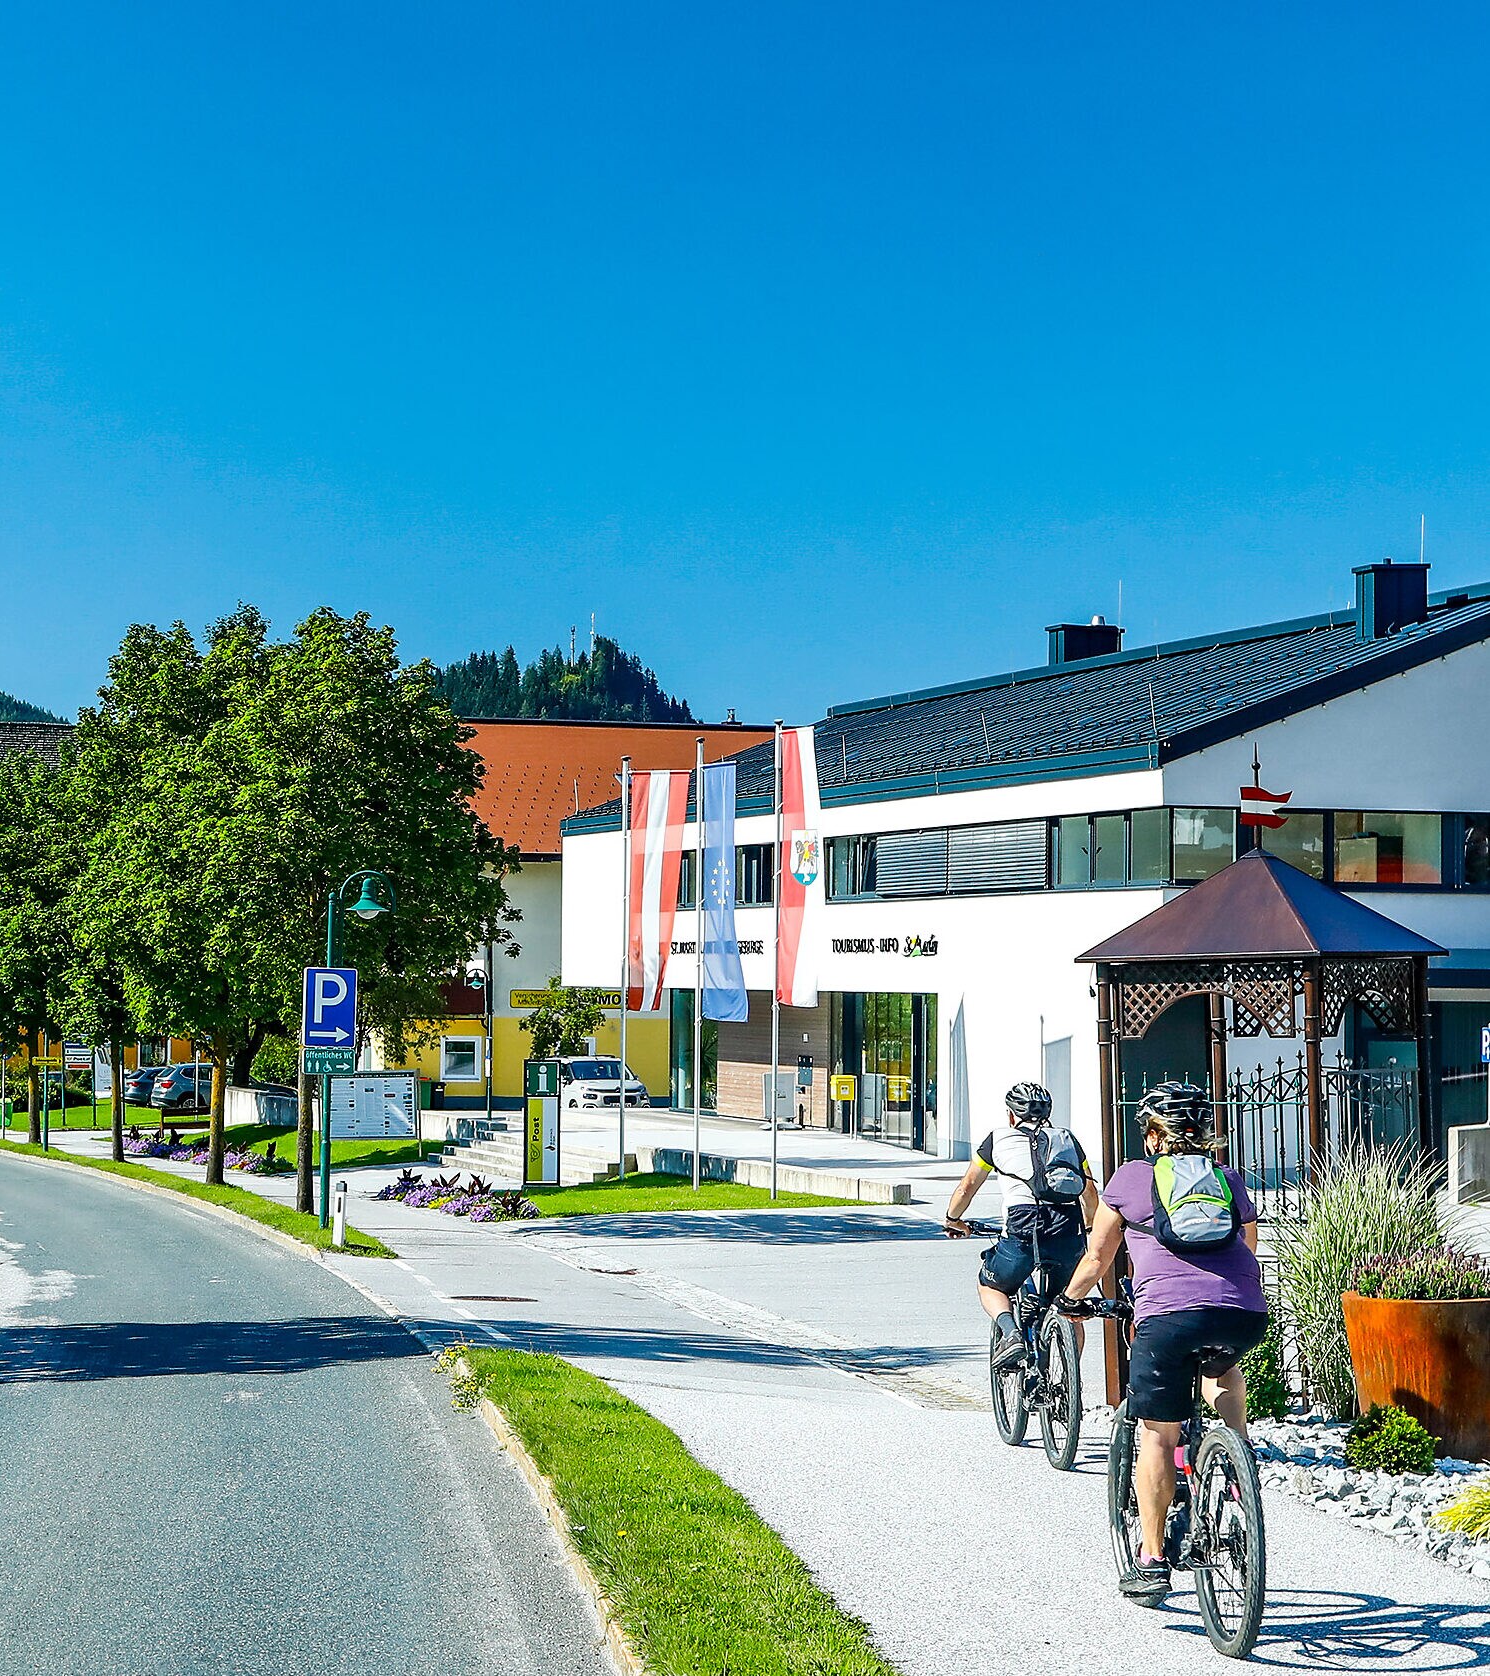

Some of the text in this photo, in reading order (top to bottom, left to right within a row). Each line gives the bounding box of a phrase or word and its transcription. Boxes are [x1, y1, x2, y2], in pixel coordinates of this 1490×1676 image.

[832, 938, 875, 954] TOURISMUS
[313, 972, 348, 1024] P
[305, 1050, 353, 1060] öffentliches WC
[532, 1117, 540, 1142] Post
